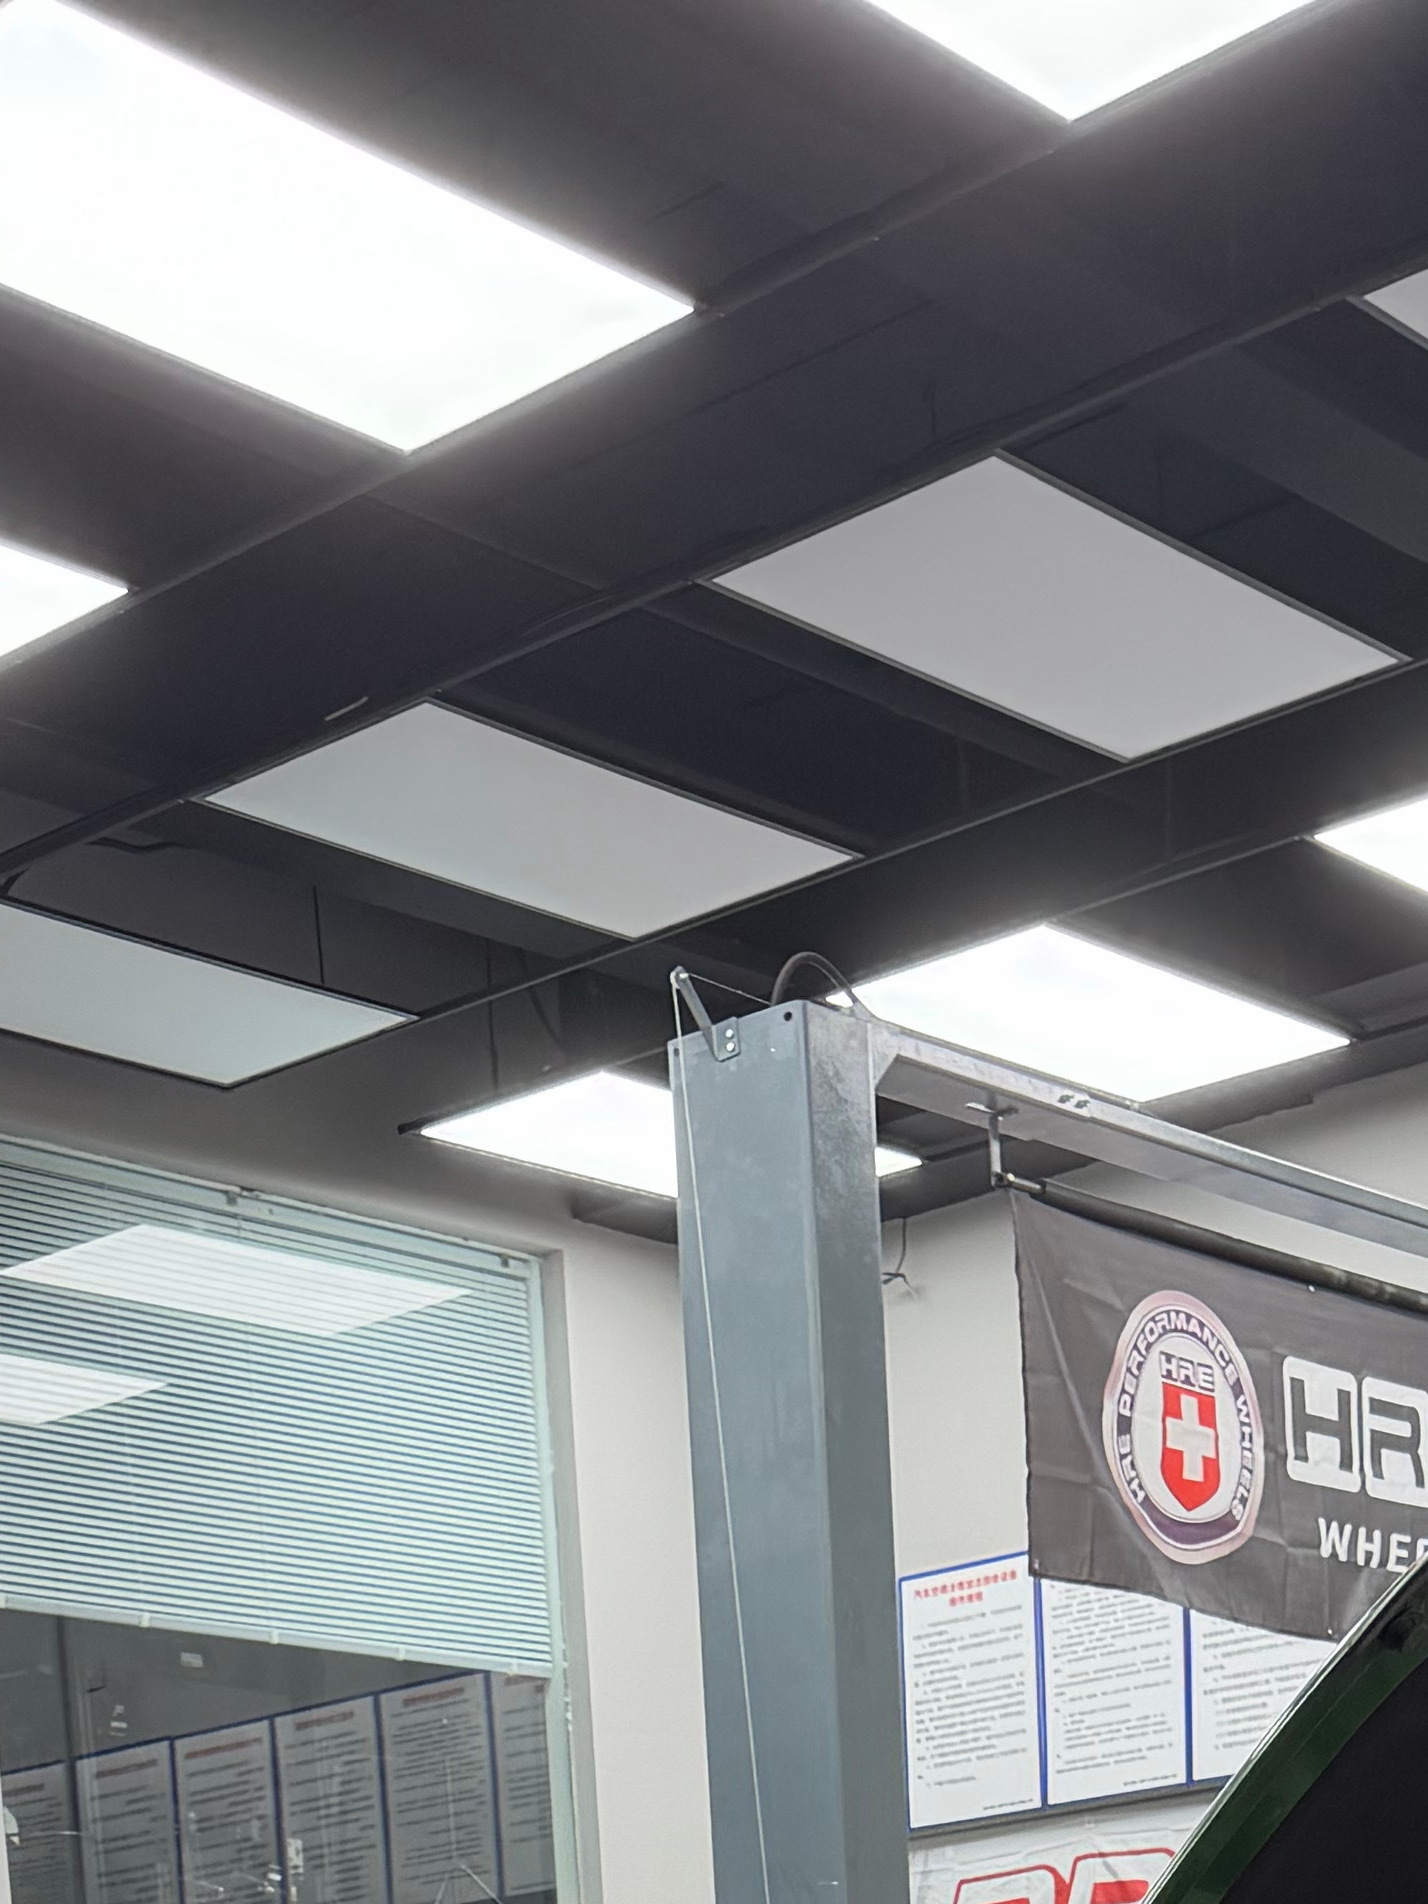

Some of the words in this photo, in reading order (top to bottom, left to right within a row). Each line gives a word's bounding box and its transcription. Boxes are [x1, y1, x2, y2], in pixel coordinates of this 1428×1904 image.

[1120, 1310, 1239, 1417] PERFORMANCE
[1159, 1351, 1215, 1392] HRE
[1119, 1433, 1145, 1503] HRE
[1231, 1394, 1254, 1520] WHEELS
